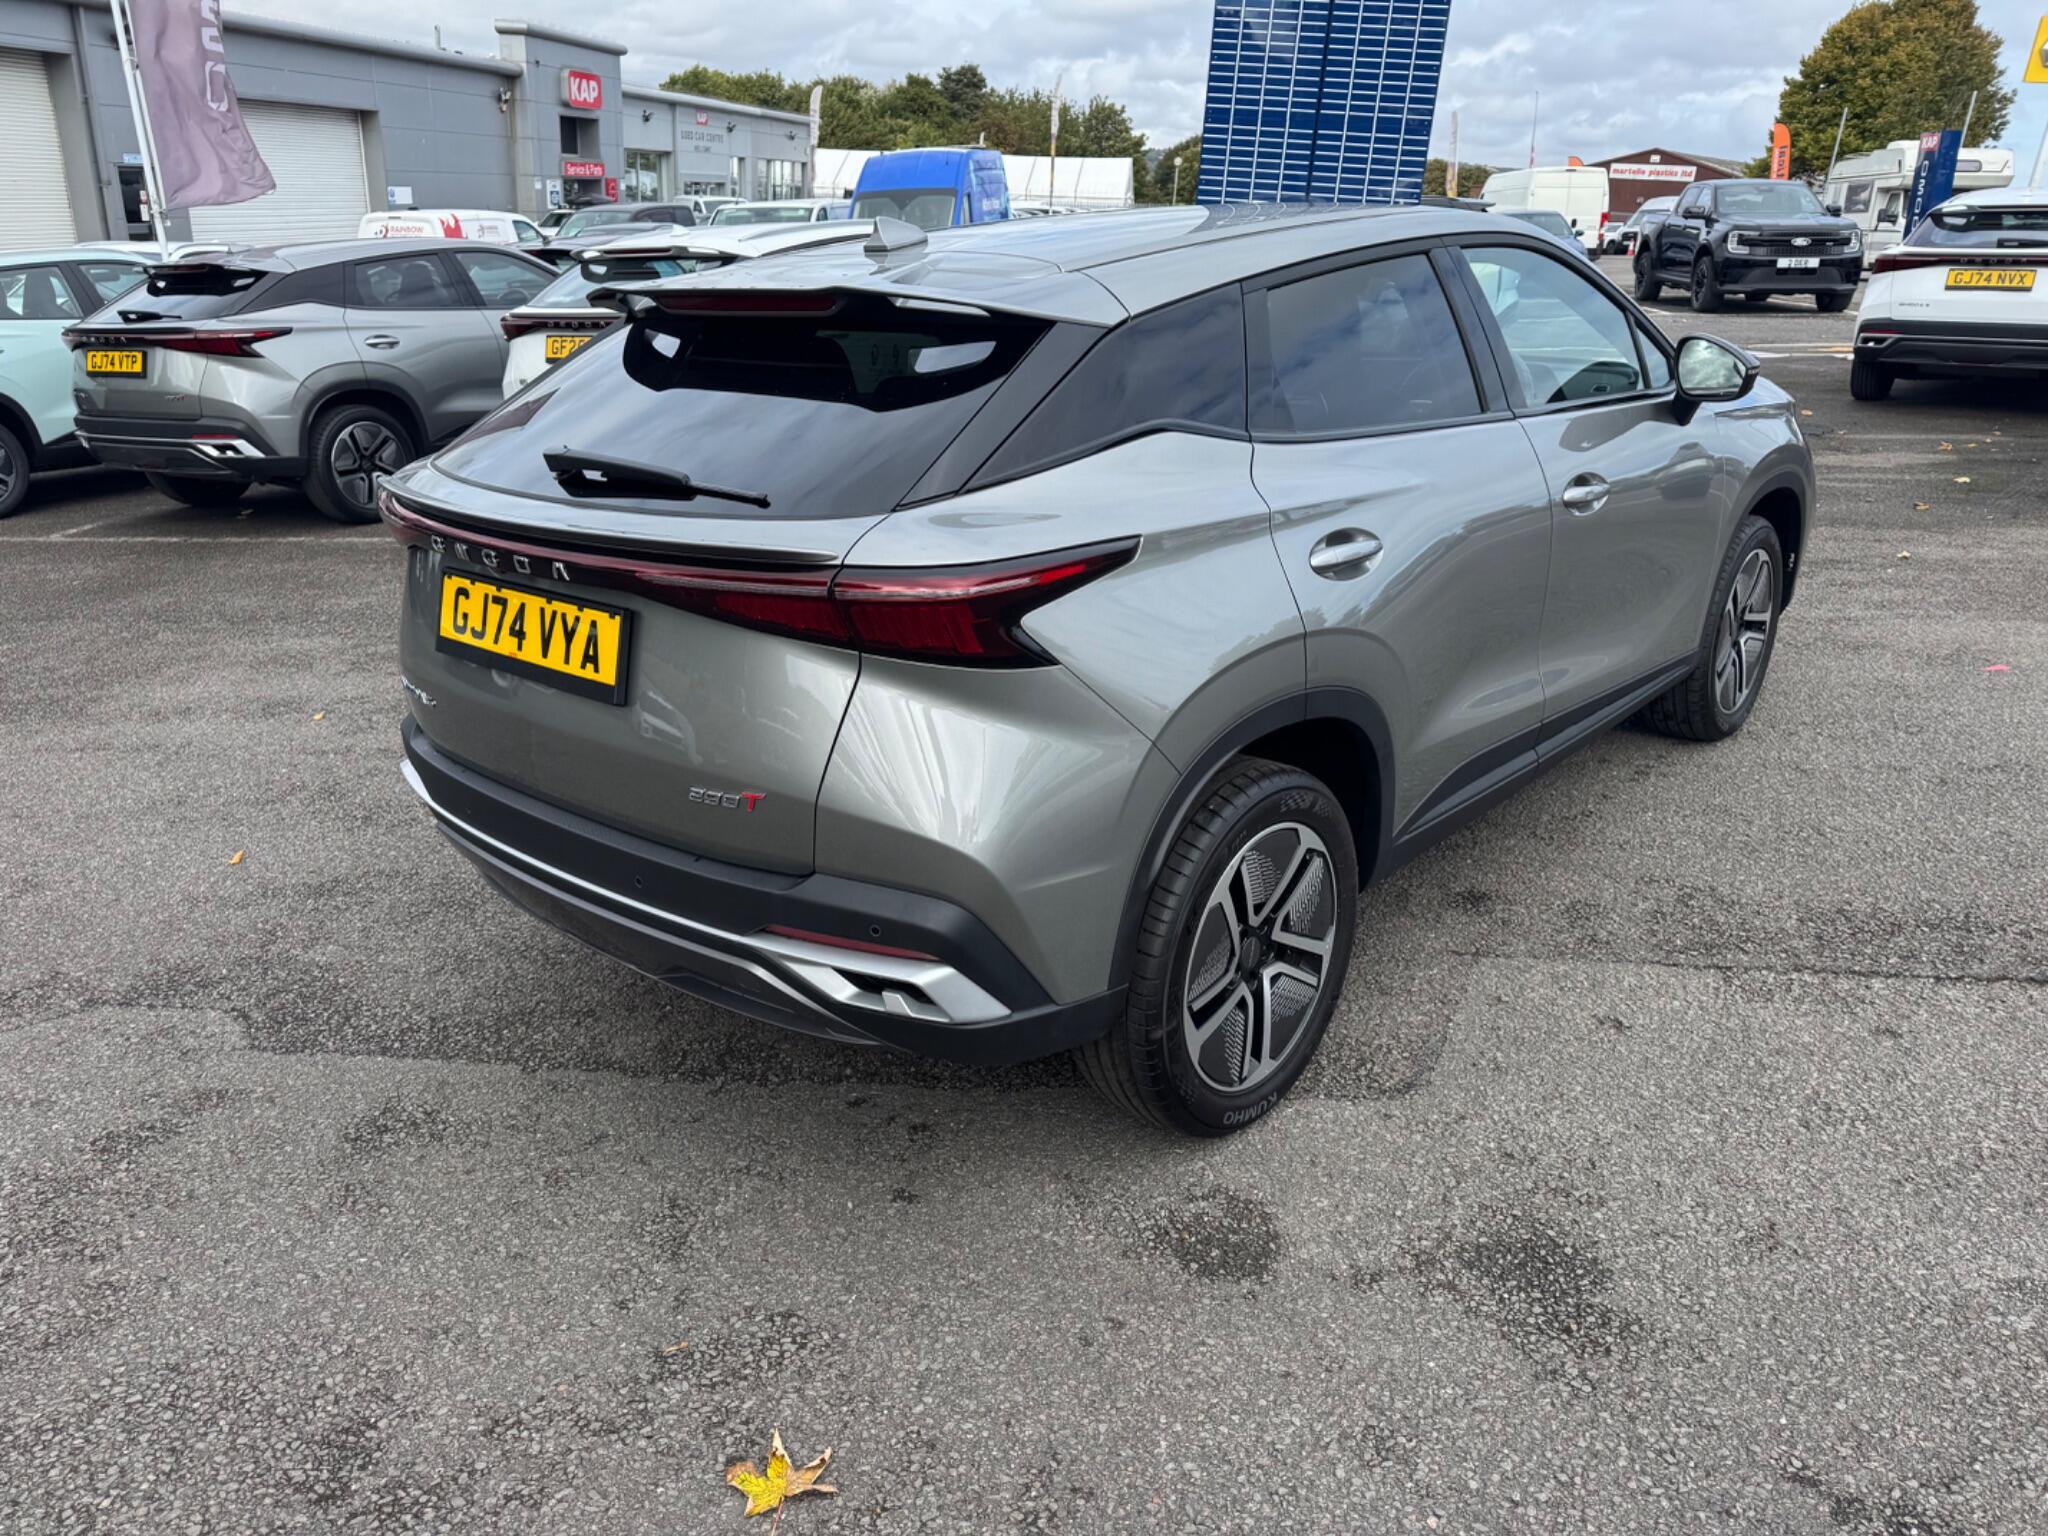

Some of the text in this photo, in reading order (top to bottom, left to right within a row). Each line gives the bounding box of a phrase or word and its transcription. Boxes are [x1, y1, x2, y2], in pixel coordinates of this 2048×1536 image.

[570, 76, 599, 103] KAP
[1921, 135, 1938, 149] KAP
[1648, 168, 1679, 178] plastics
[1681, 169, 1693, 177] ltd
[390, 225, 424, 234] RAINBOW
[1954, 272, 2028, 285] GJ74 NVX
[91, 354, 138, 369] GJ74 VTP
[453, 587, 600, 674] GJ74 VYA
[1223, 1091, 1277, 1124] KUMHO
